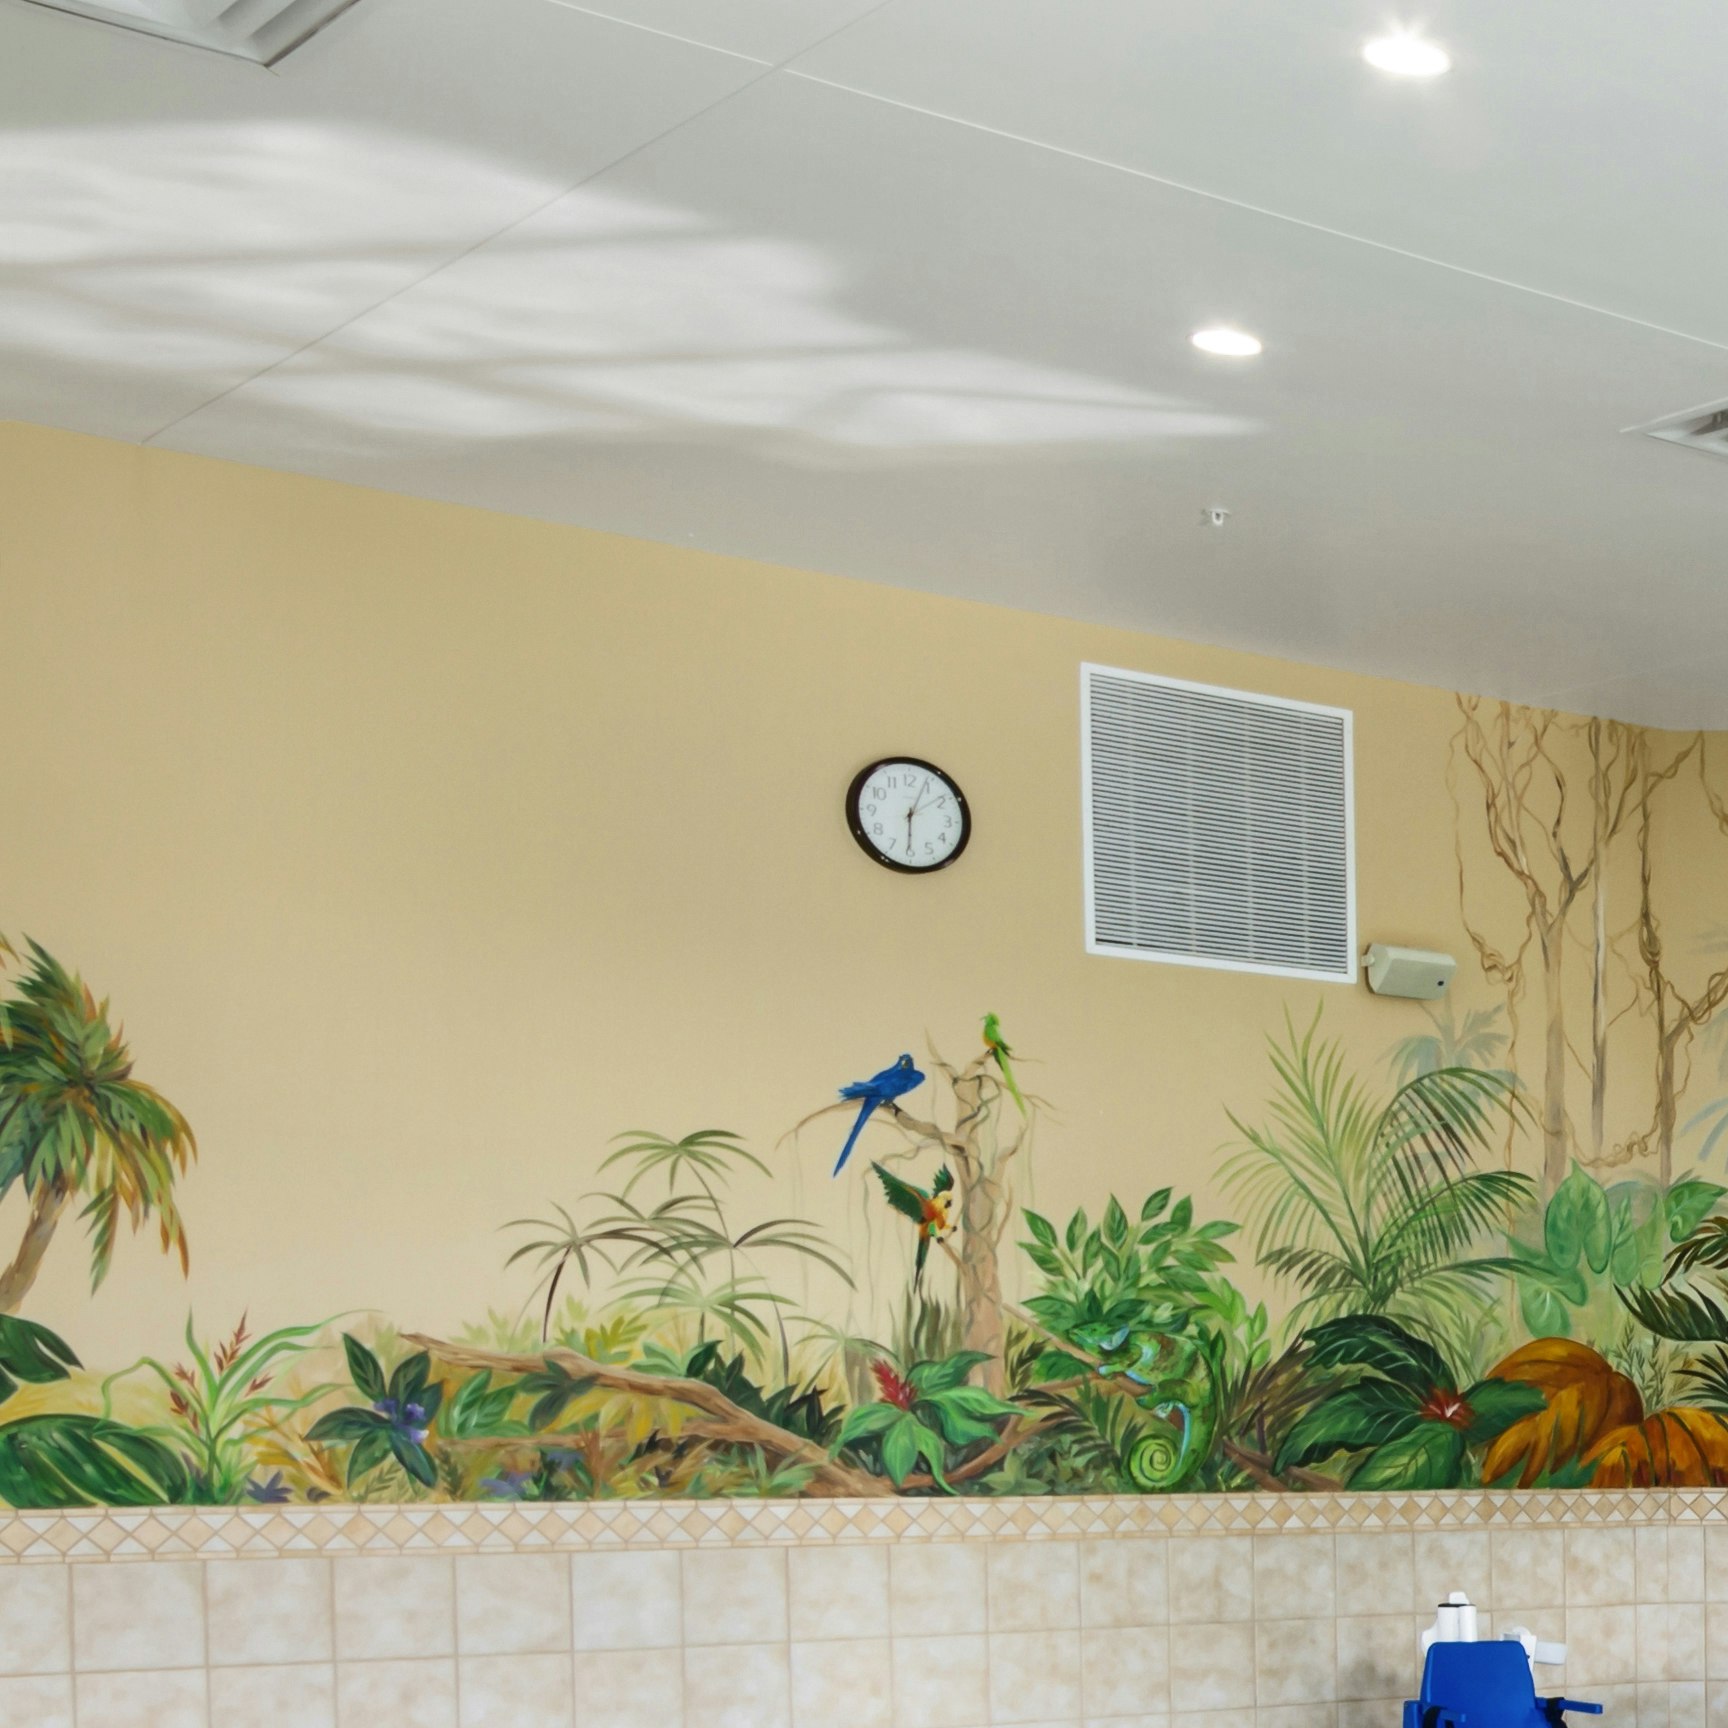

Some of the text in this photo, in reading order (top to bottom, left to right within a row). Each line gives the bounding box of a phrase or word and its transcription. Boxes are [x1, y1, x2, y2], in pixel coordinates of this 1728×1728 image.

[888, 776, 897, 788] 11
[904, 774, 916, 787] 12
[873, 787, 887, 800] 10
[867, 804, 877, 816] 9
[944, 815, 952, 828] 3
[873, 823, 883, 835] 8
[889, 838, 896, 850] 7
[938, 833, 946, 844] 4
[925, 842, 934, 855] 5
